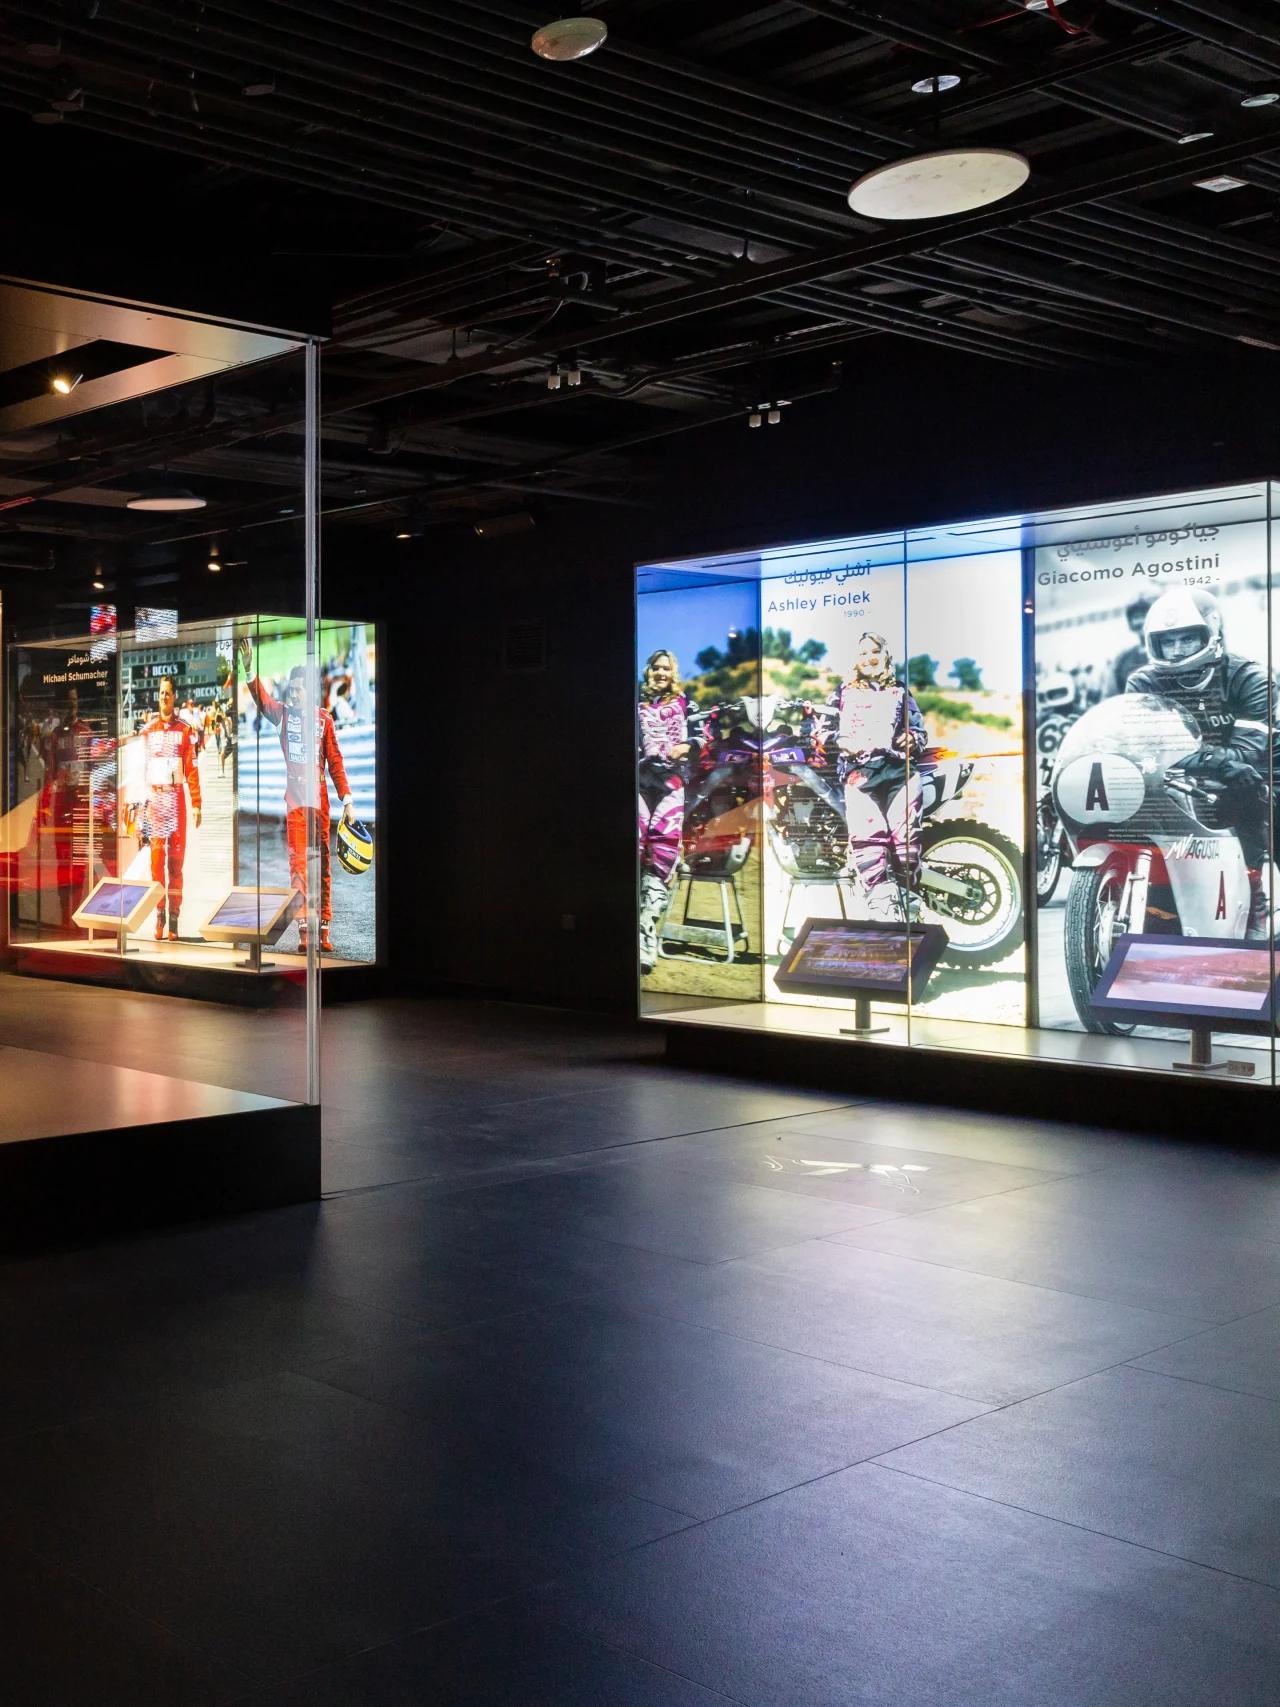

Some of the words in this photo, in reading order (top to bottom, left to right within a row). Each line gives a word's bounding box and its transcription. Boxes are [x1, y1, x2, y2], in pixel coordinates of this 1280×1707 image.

[1037, 567, 1124, 586] Giacomo
[1131, 553, 1220, 578] Agostini
[1184, 576, 1212, 587] 1942
[767, 597, 817, 613] Ashley
[823, 590, 871, 608] Fiolek
[43, 672, 67, 684] Michael
[68, 669, 109, 682] Schumacher
[152, 663, 179, 676] BECK'S
[1086, 762, 1110, 812] A
[1215, 870, 1227, 921] A
